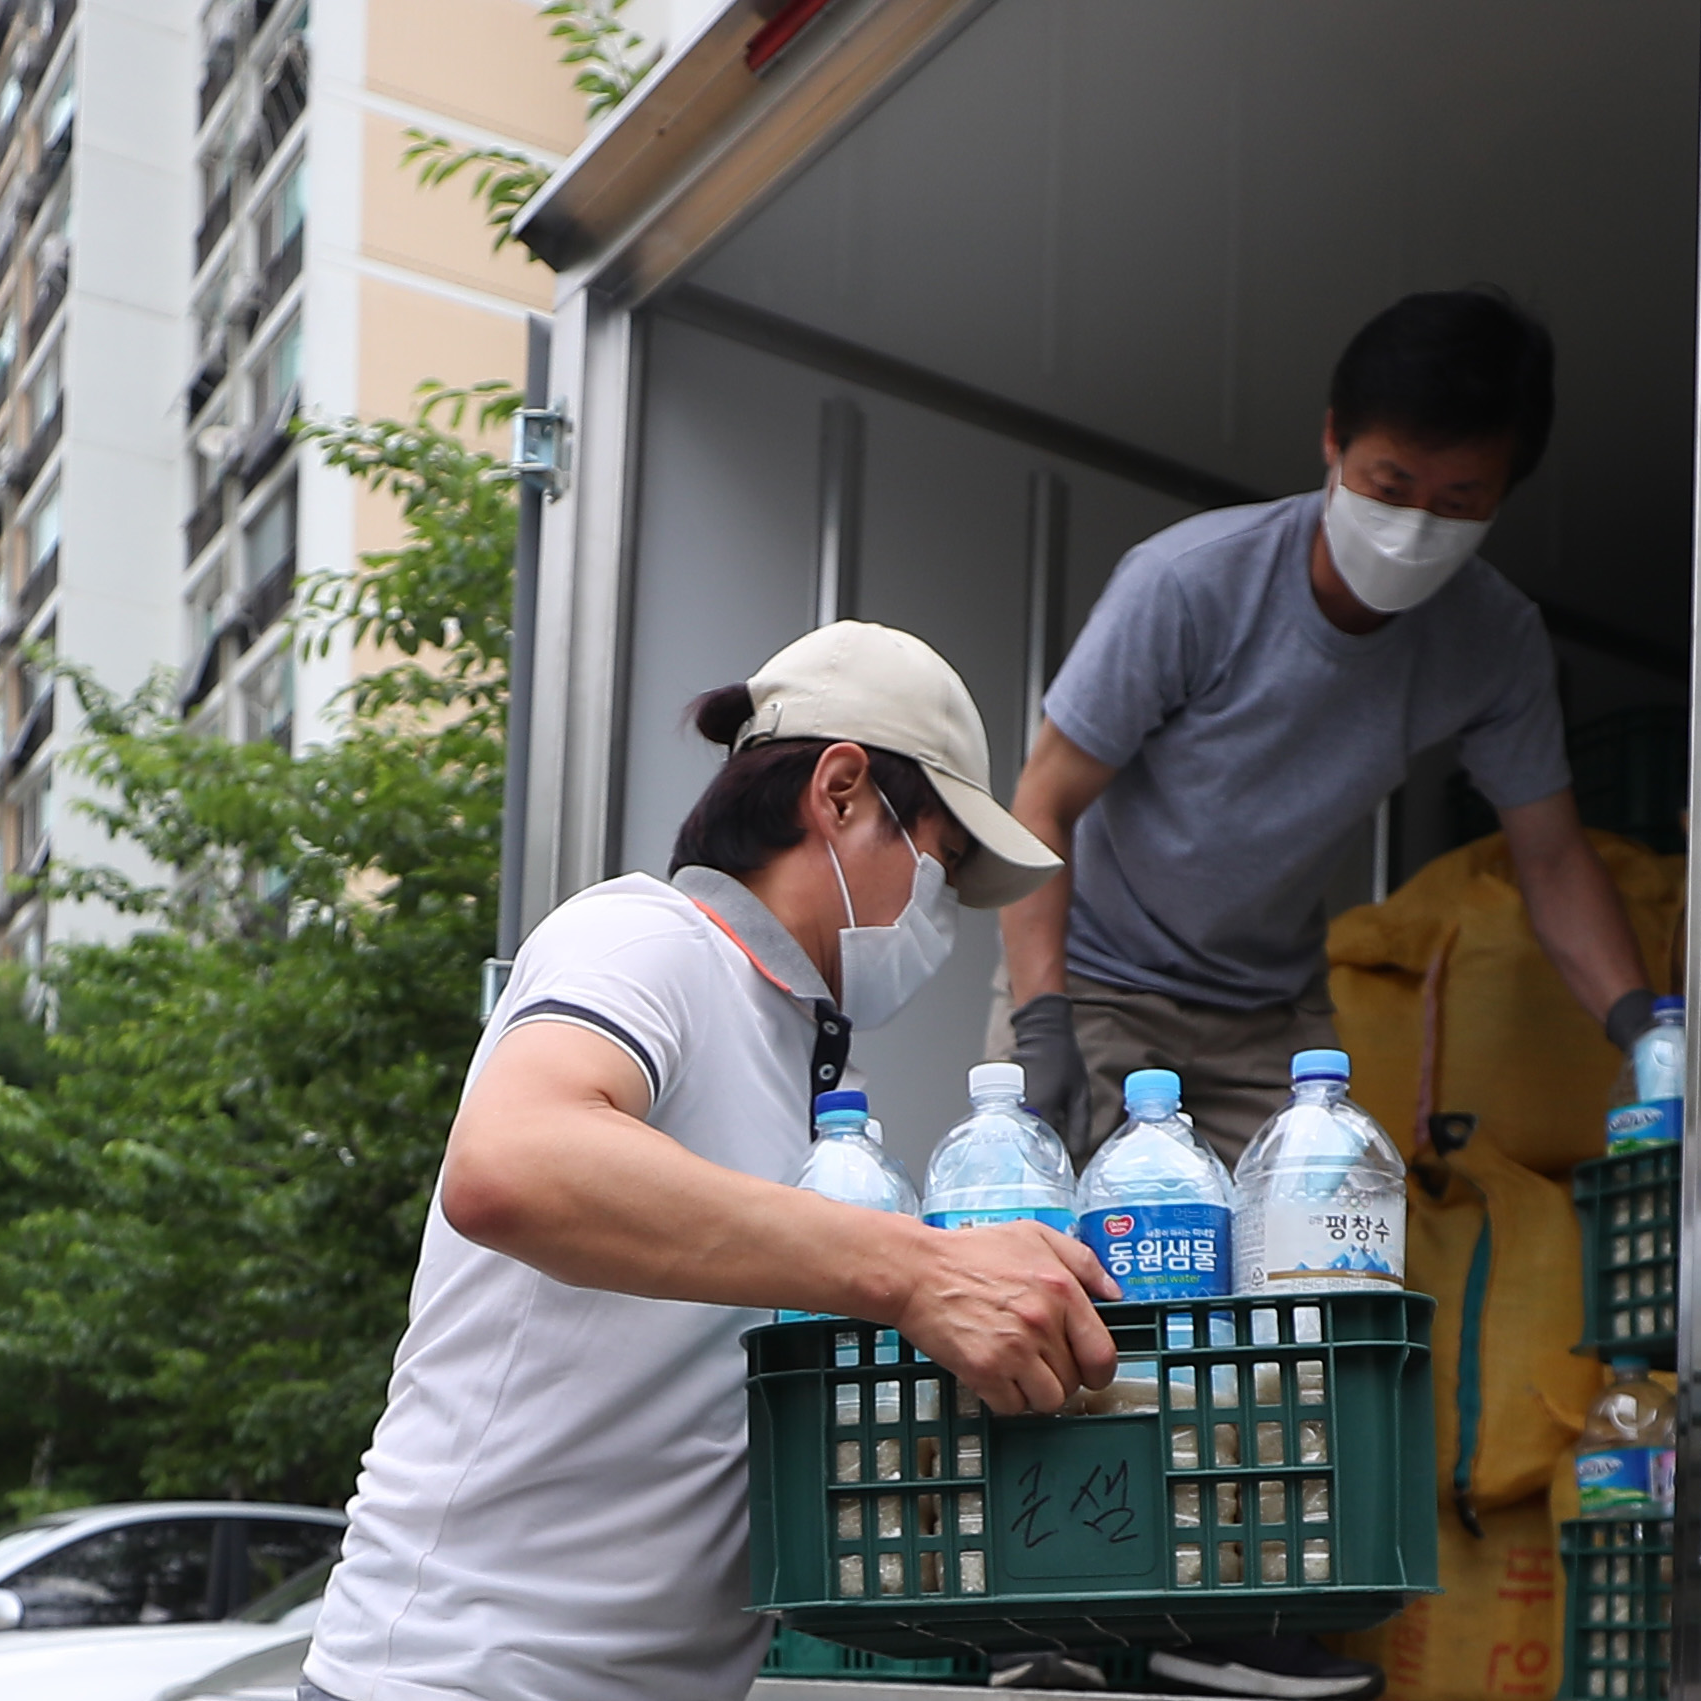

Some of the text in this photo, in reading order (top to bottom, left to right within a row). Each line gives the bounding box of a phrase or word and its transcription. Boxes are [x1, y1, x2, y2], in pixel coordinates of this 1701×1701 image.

[1325, 1214, 1391, 1244] 평창수
[1107, 1239, 1218, 1276] 동원샘물
[1127, 1275, 1201, 1285] mineral water
